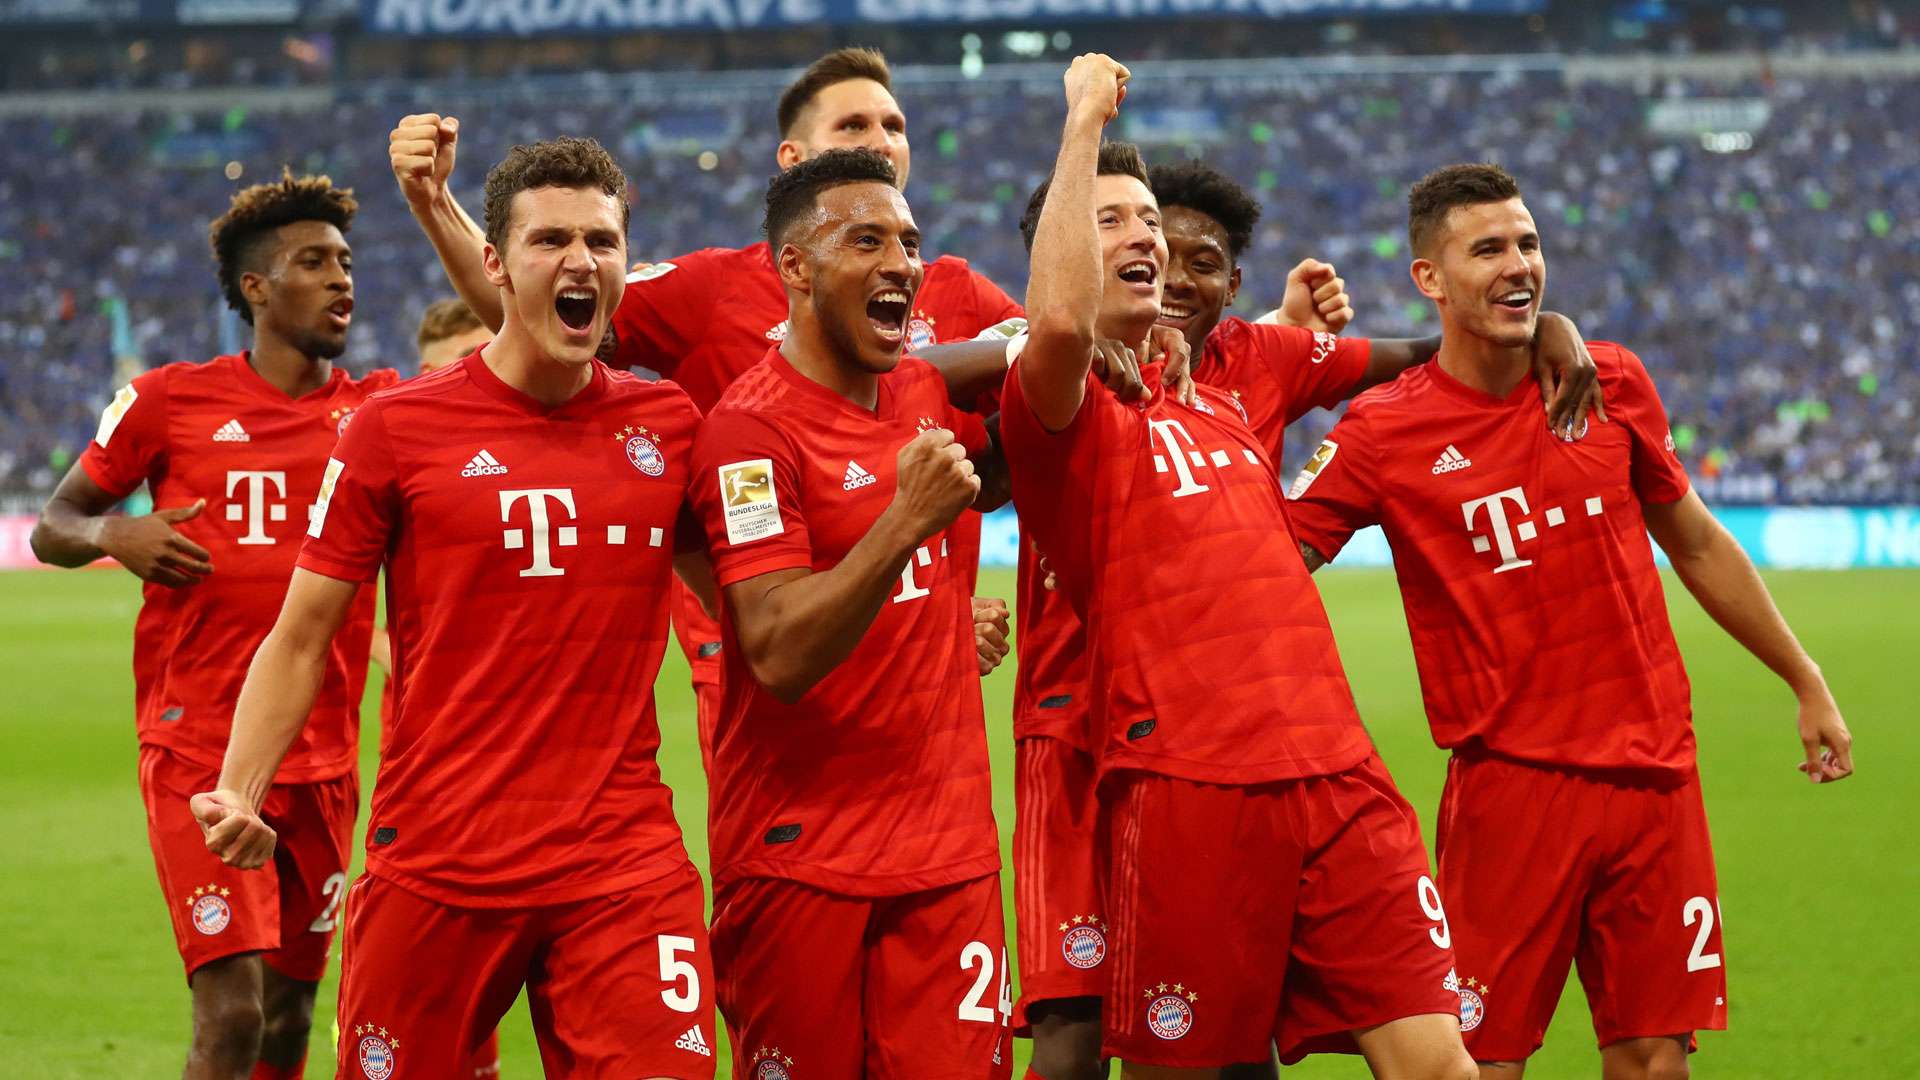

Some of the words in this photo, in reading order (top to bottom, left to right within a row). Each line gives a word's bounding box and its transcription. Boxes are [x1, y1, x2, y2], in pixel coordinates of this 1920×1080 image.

[461, 464, 509, 478] adidas
[1431, 458, 1472, 475] adidas
[843, 474, 877, 491] adidas
[728, 502, 774, 517] BUNDESLIGA
[309, 871, 345, 933] 2
[1418, 875, 1451, 950] 9
[1075, 929, 1103, 946] BAYERN
[1683, 895, 1722, 973] 2
[658, 934, 700, 1013] 5
[958, 940, 1013, 1028] 24
[1160, 998, 1189, 1016] BAYERN
[1460, 991, 1481, 1009] AYERN
[368, 1039, 391, 1061] BAYERN
[675, 1039, 711, 1057] adidas
